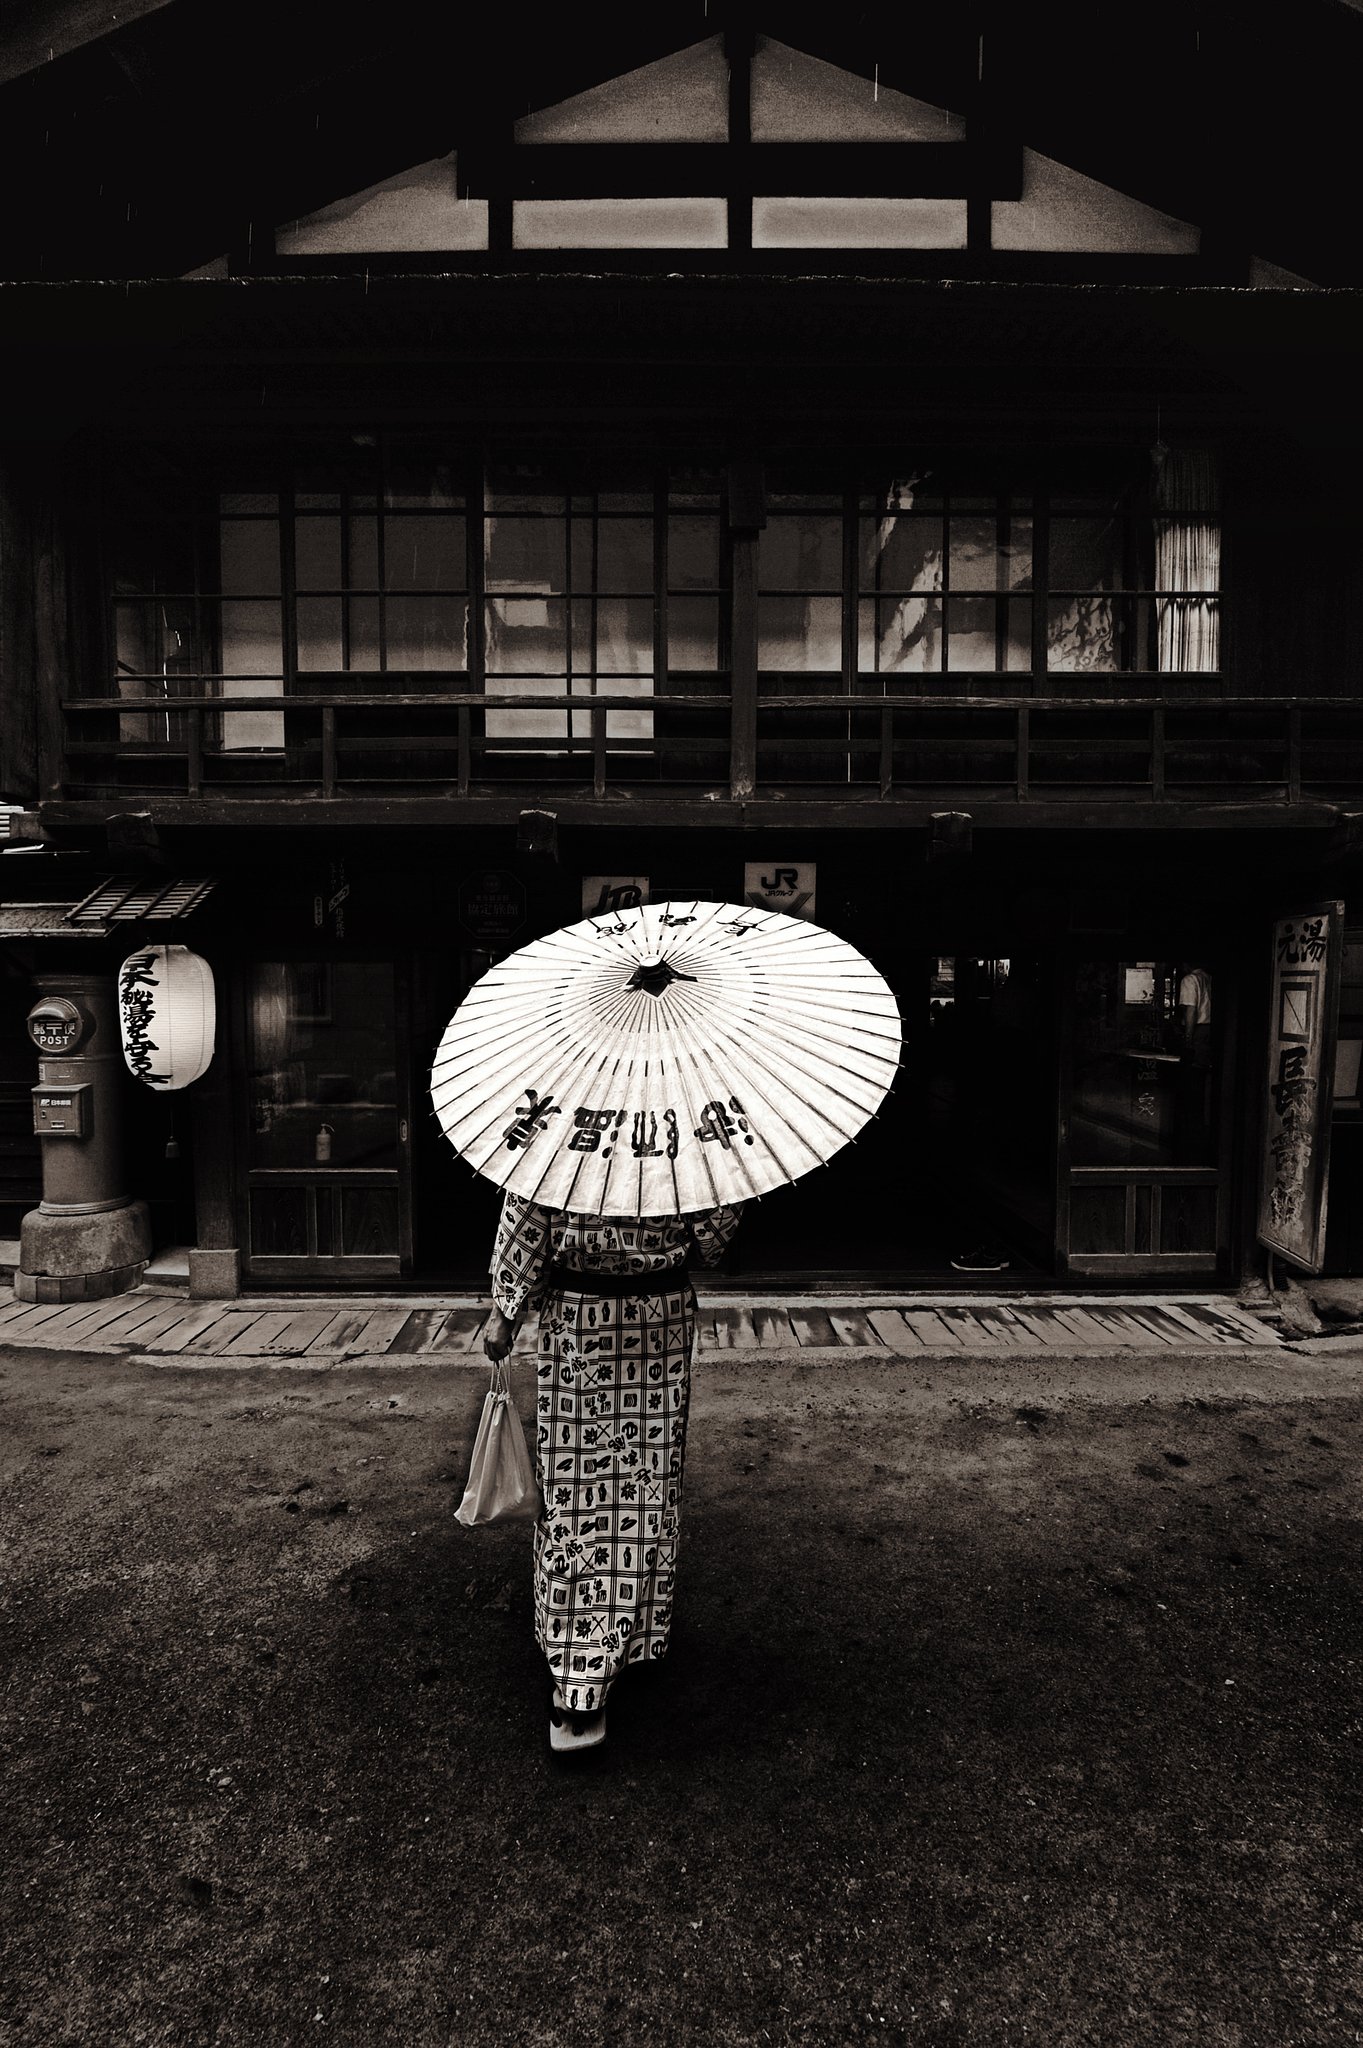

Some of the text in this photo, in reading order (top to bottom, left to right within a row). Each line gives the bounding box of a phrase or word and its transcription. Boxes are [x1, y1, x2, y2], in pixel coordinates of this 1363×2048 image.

[761, 868, 798, 890] JR
[590, 885, 642, 914] JTB
[39, 1036, 69, 1045] POST
